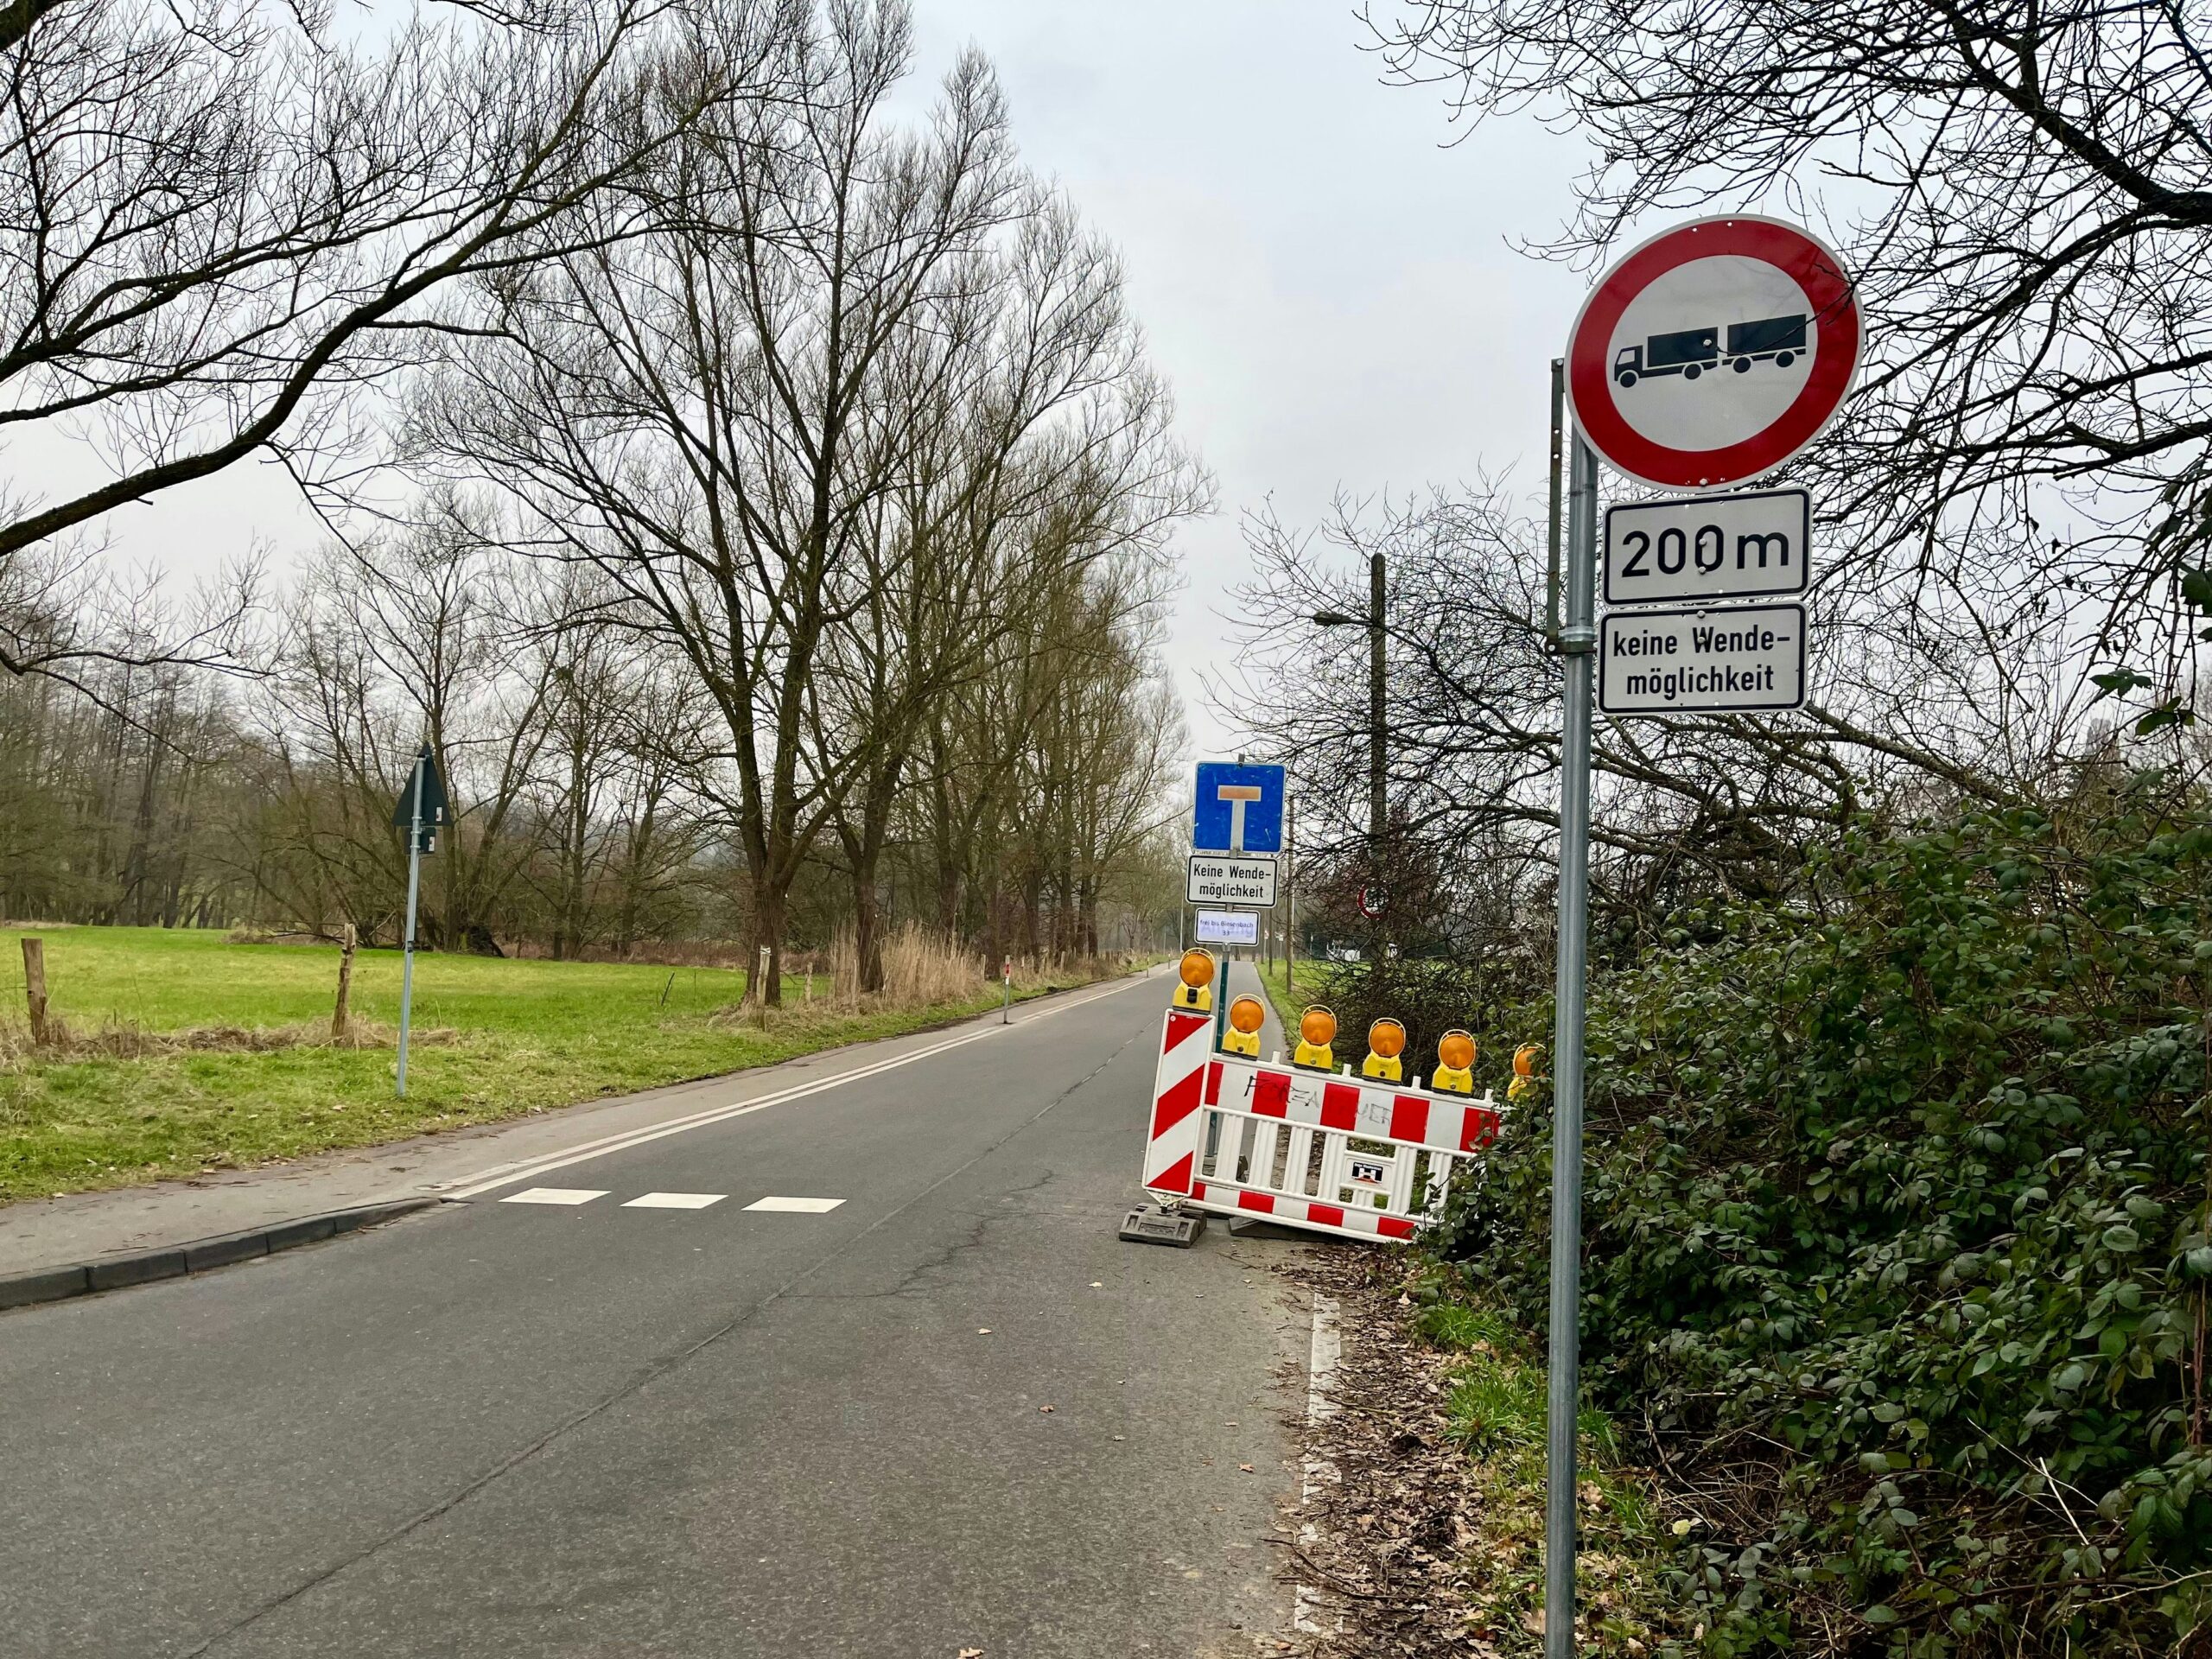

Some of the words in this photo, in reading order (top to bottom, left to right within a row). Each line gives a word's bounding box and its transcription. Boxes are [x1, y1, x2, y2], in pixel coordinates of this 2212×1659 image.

[1613, 629, 1678, 657] keine
[1692, 624, 1790, 654] Wende-
[1626, 664, 1774, 701] möglichkeit
[1193, 863, 1224, 878] Keine
[1229, 865, 1272, 880] Wende-
[1199, 882, 1264, 899] möglichkeit
